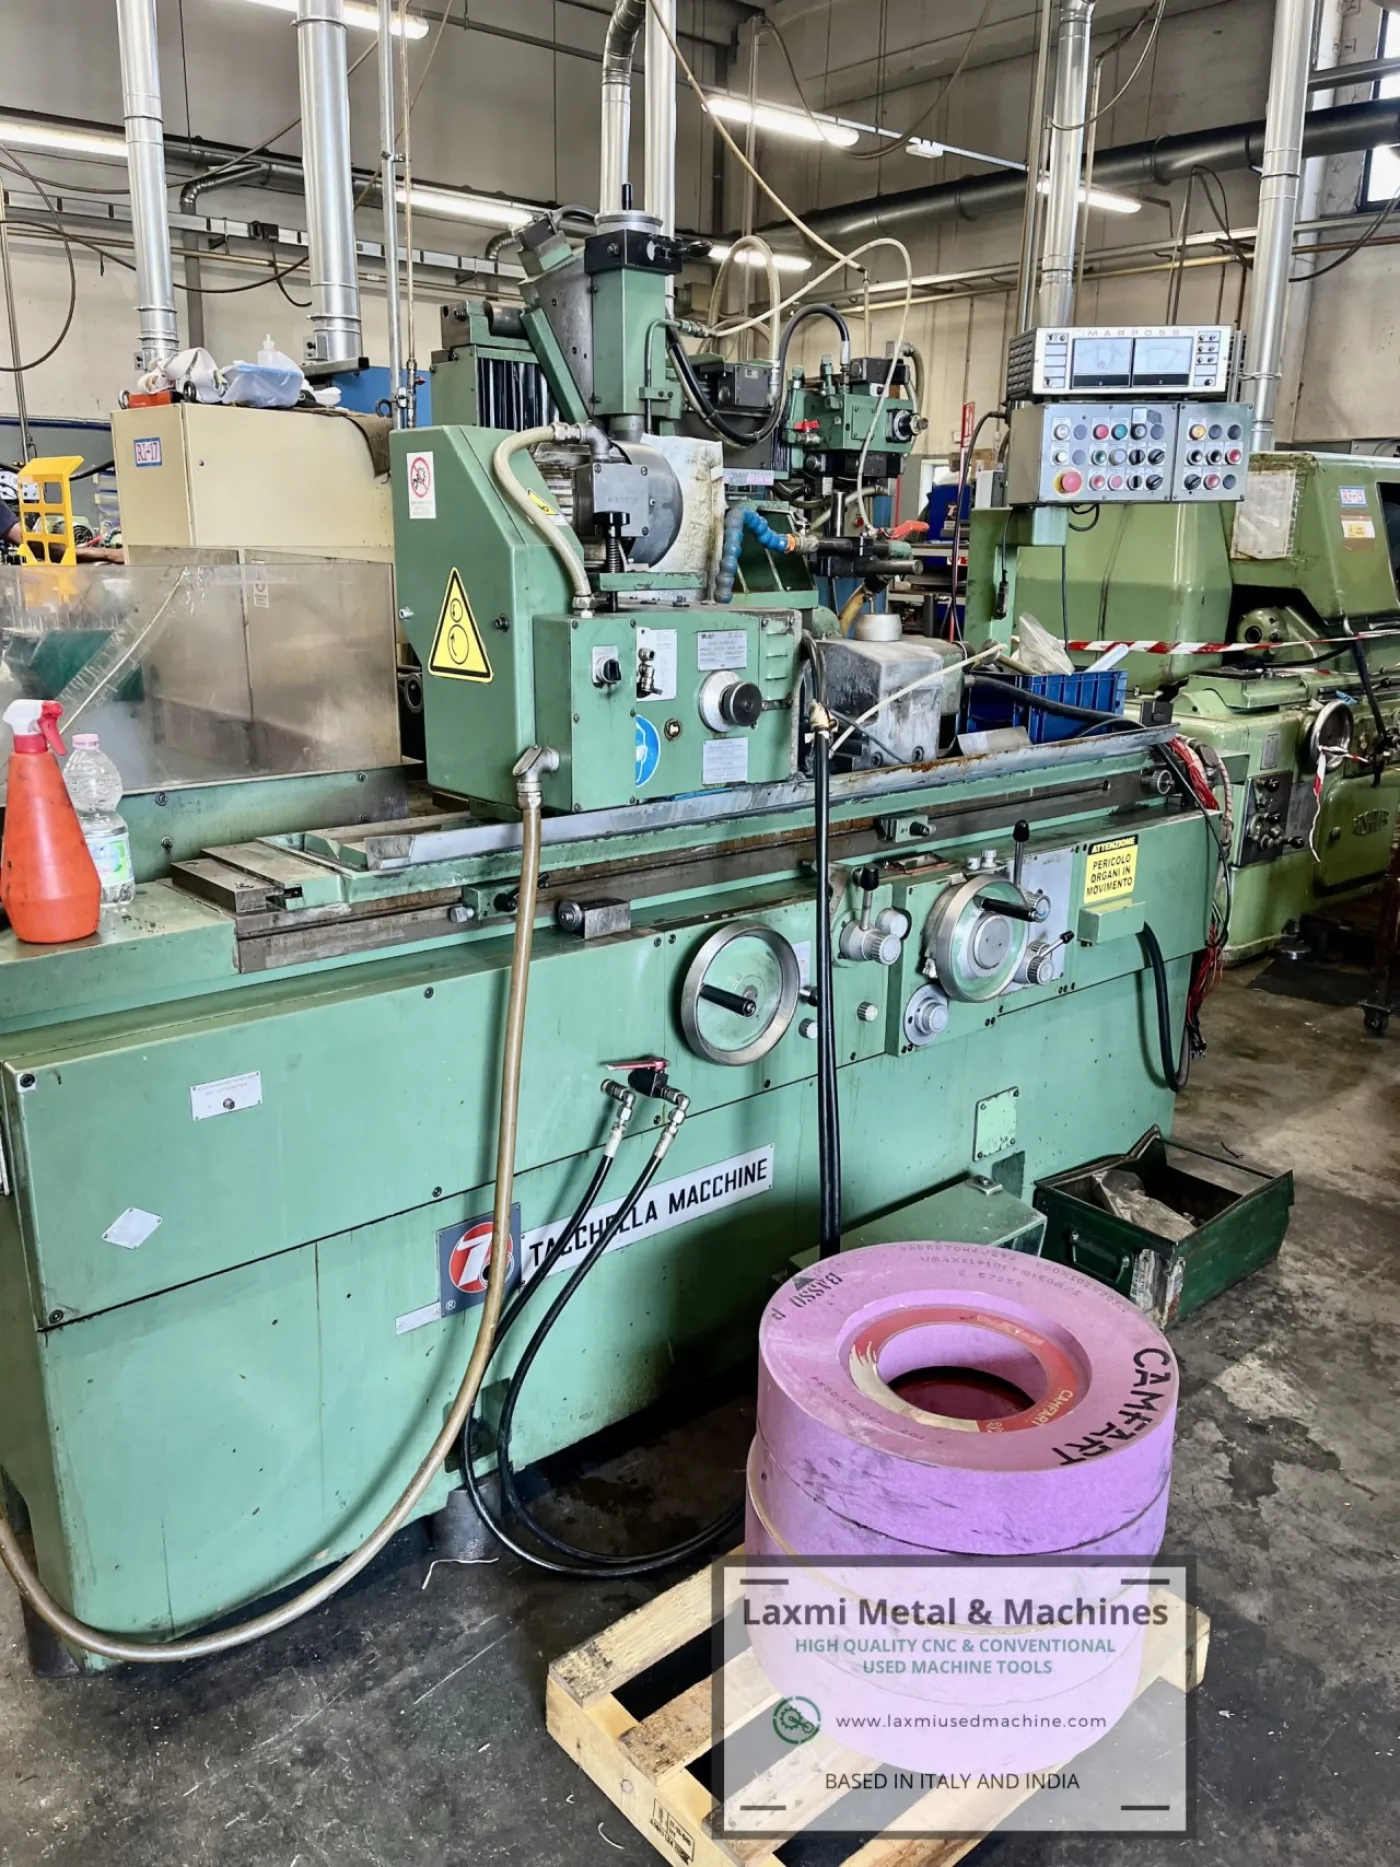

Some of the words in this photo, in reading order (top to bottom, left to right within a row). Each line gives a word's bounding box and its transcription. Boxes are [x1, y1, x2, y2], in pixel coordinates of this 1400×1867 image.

[1087, 328, 1181, 337] MARPOSS
[1093, 853, 1131, 871] PERICOLO
[1090, 868, 1121, 884] ORGANI
[1122, 865, 1131, 876] IN
[1086, 876, 1133, 896] MOVIMENTO
[668, 1157, 768, 1215] MACCHINE
[788, 1271, 844, 1308] BASSO
